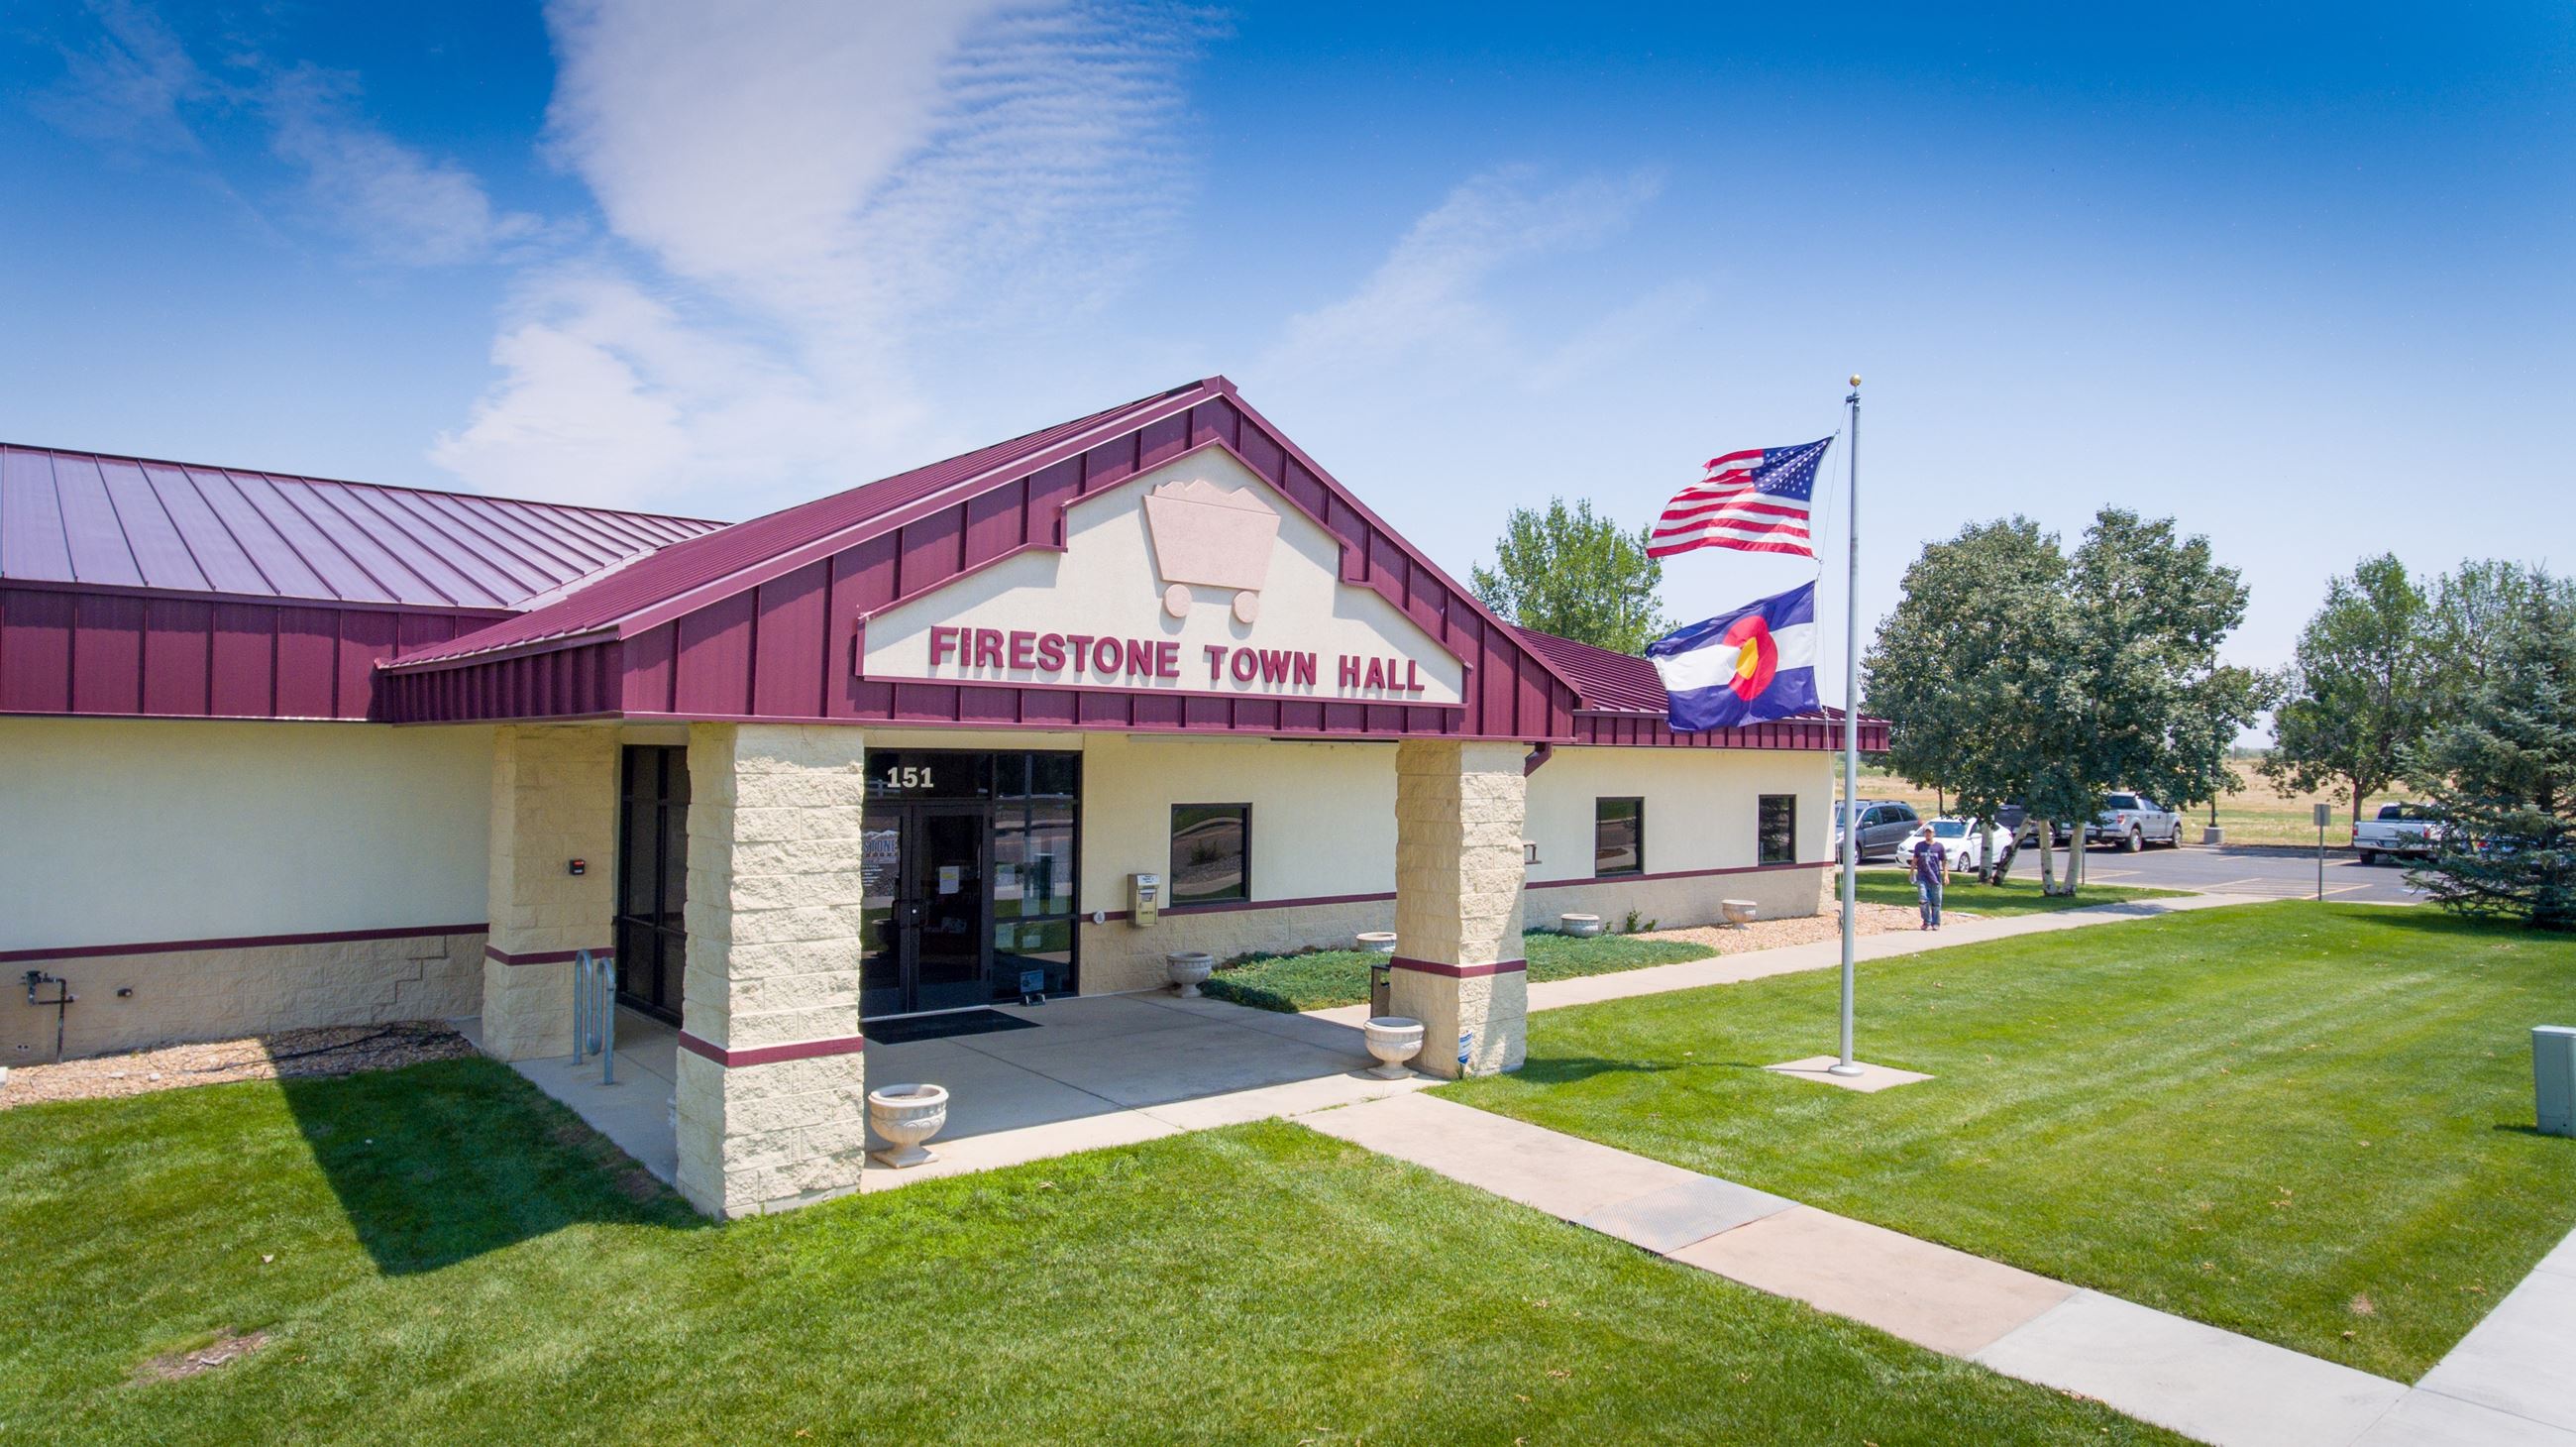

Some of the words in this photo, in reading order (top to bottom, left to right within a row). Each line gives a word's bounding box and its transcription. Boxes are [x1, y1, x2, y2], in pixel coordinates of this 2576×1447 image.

[930, 625, 1180, 678] FIRESTONE
[1204, 644, 1317, 685] TOWN
[1340, 654, 1425, 691] HALL
[888, 766, 934, 788] 151
[864, 839, 897, 852] STONE
